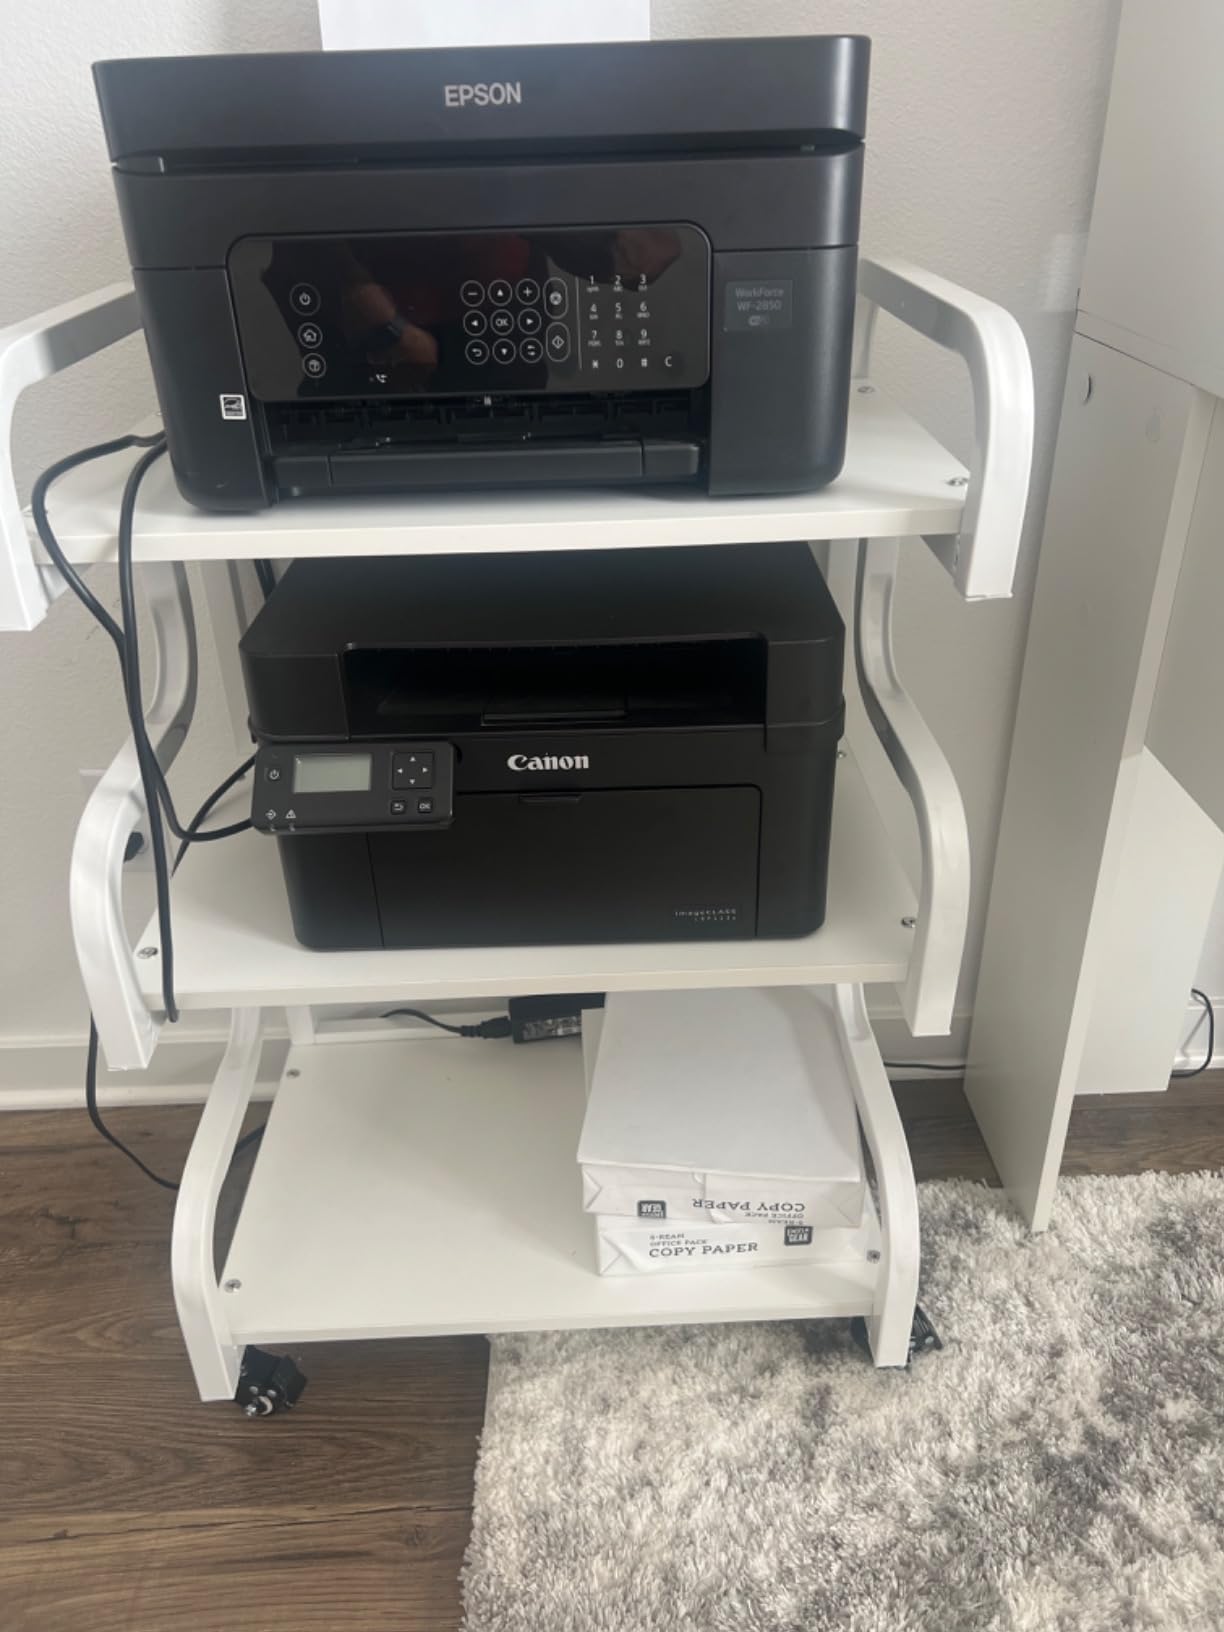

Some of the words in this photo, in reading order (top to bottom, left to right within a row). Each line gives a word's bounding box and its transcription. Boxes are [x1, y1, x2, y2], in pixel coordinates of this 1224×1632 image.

[444, 81, 522, 107] EPSON
[589, 275, 595, 285] 1
[614, 274, 622, 285] 2
[639, 273, 647, 285] 3
[590, 303, 598, 313] 4
[615, 302, 622, 312] 5
[639, 301, 647, 312] 6
[495, 318, 509, 327] OK
[591, 329, 598, 340] 7
[615, 329, 623, 340] 8
[640, 328, 648, 339] 9
[664, 355, 673, 368] C
[507, 753, 589, 771] Canon
[419, 803, 431, 811] OK
[692, 1198, 750, 1211] PAPER
[757, 1202, 805, 1213] COPY
[649, 1247, 696, 1258] COPY
[702, 1242, 758, 1255] PAPER
